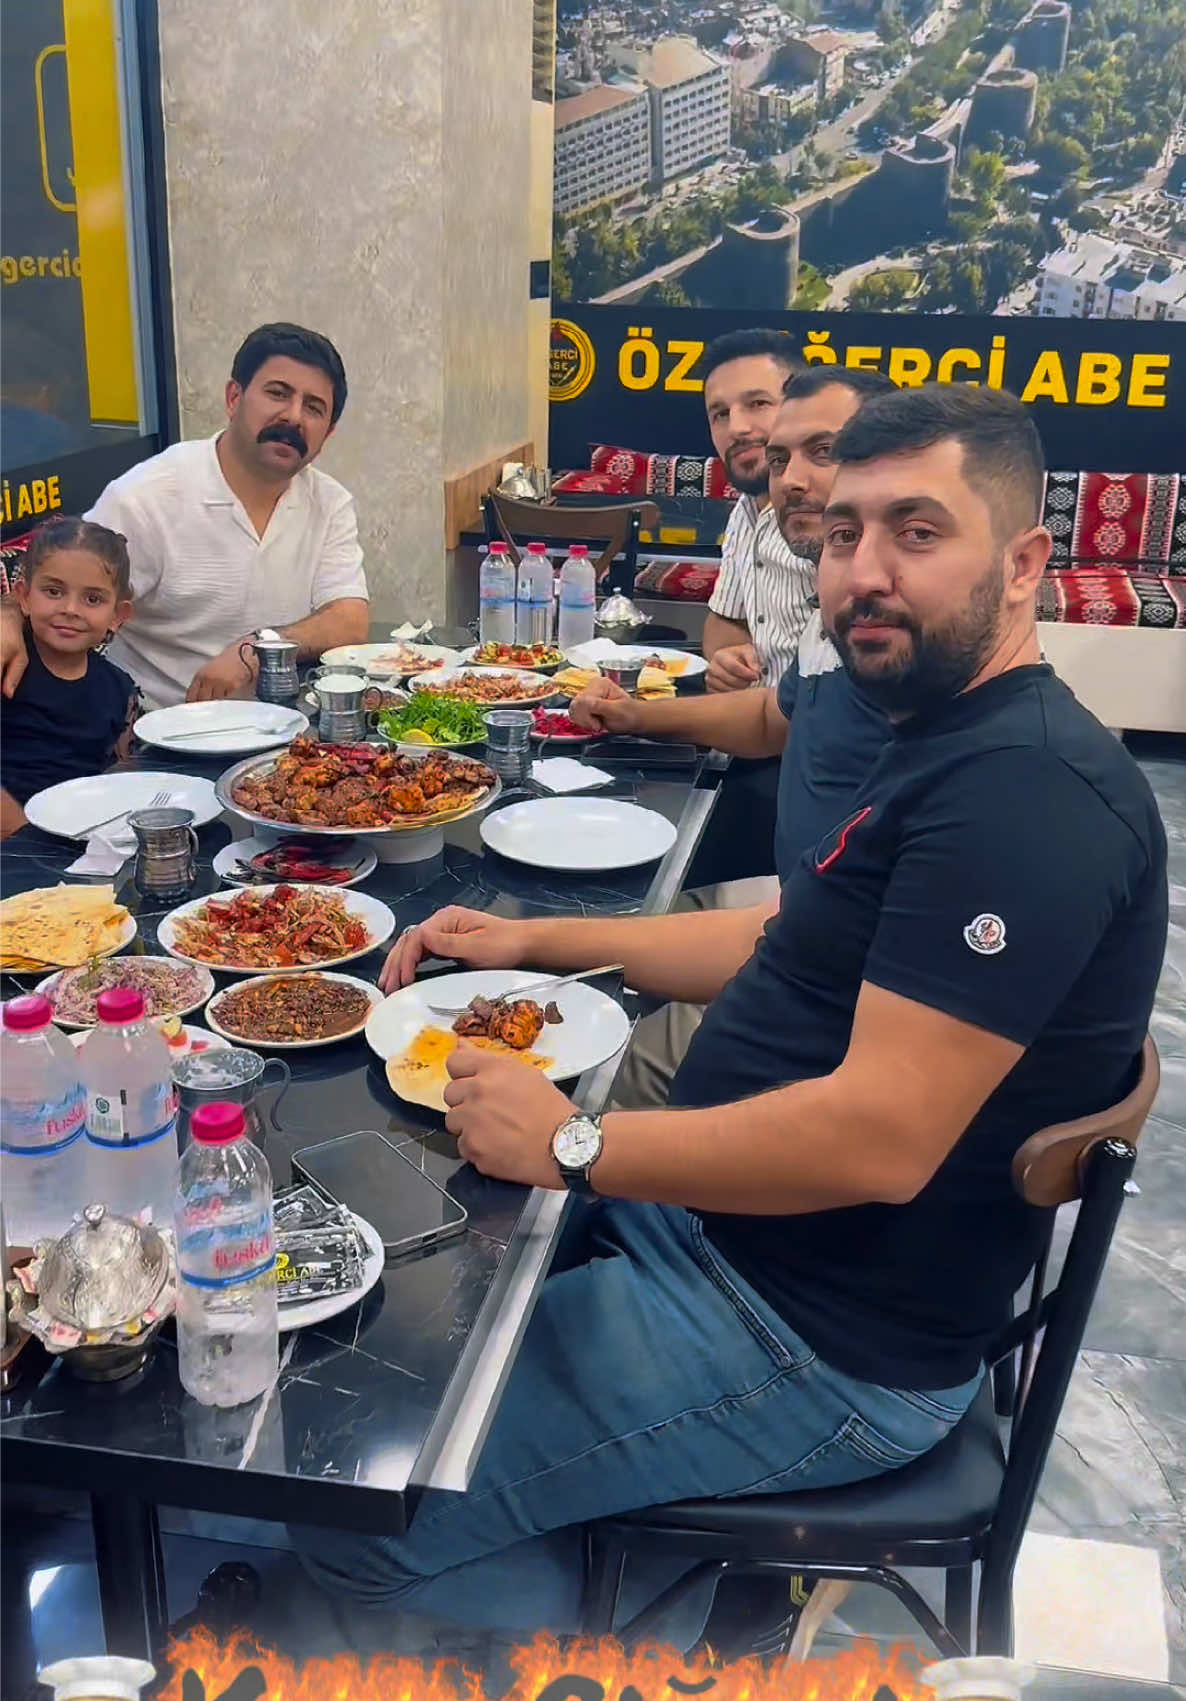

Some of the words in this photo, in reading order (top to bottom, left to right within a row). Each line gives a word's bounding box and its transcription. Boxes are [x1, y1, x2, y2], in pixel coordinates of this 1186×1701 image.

[618, 326, 705, 392] ÖZ
[1020, 350, 1171, 408] ABE
[18, 475, 62, 519] ABE
